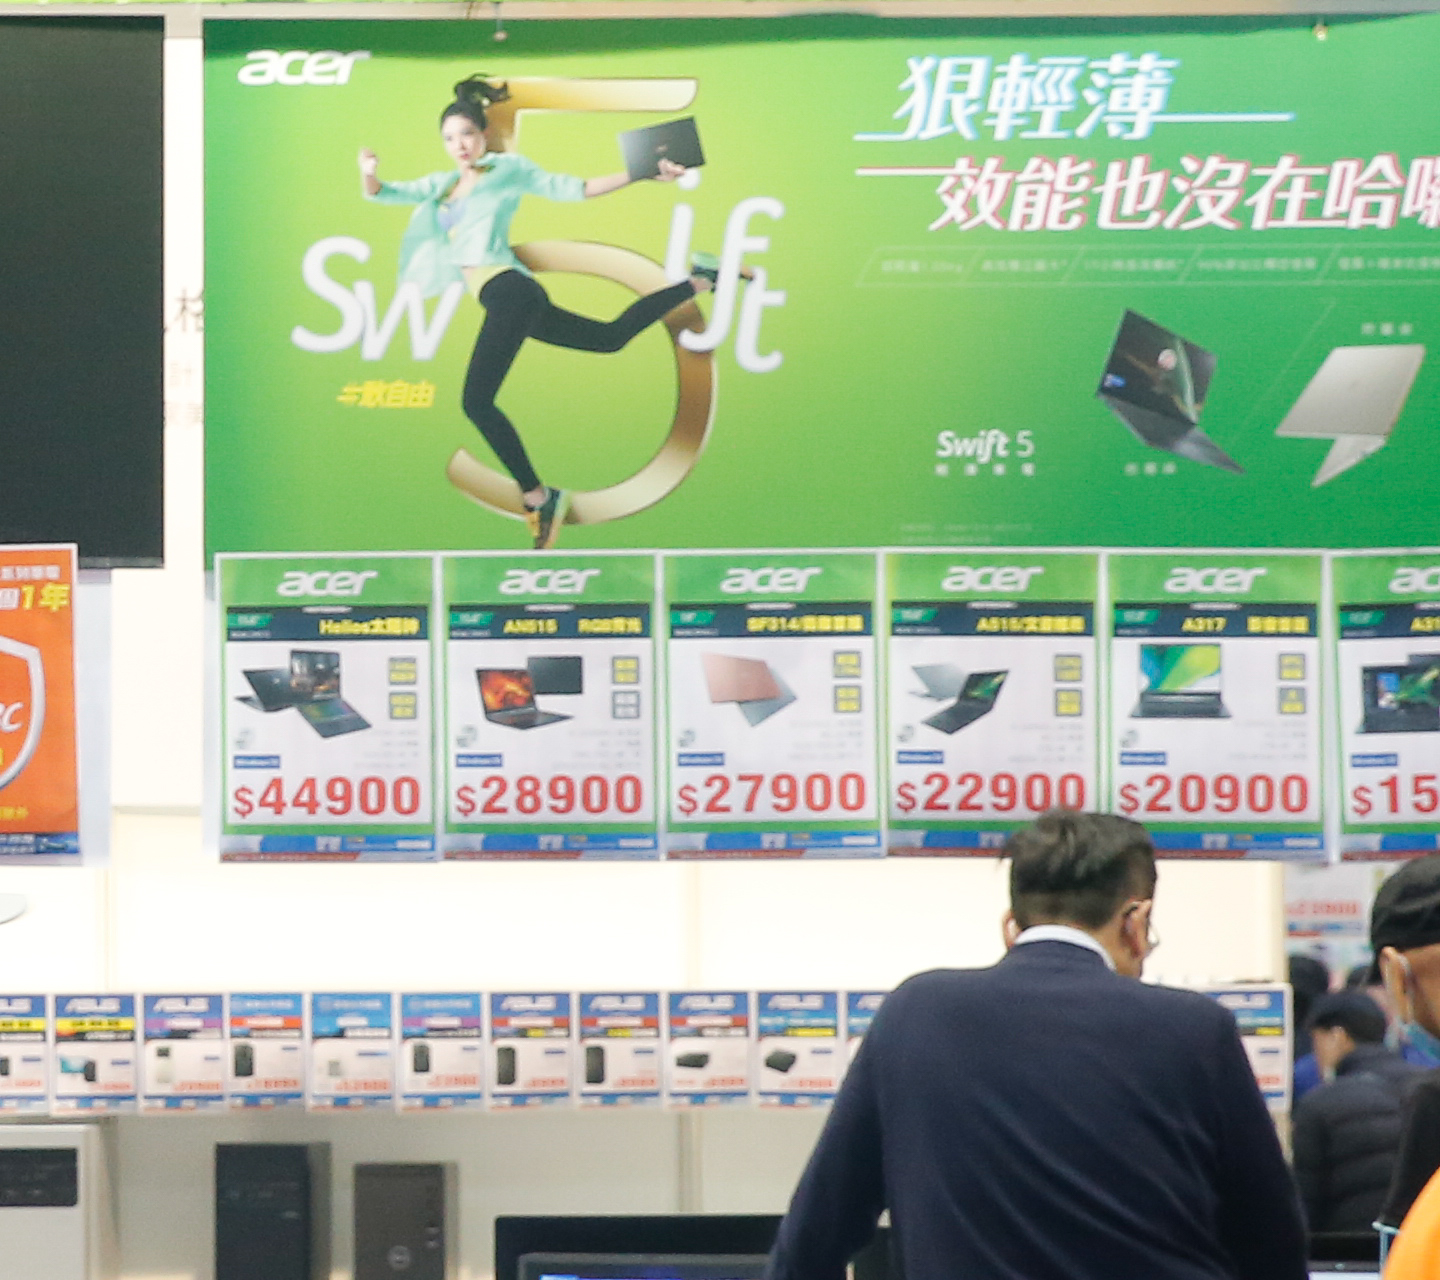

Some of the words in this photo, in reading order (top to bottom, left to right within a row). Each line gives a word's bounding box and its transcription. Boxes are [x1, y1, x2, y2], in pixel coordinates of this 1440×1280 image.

[237, 50, 370, 86] acer
[893, 53, 1180, 141] 狠輕薄
[936, 429, 1010, 459] Swift
[1016, 429, 1035, 458] 5
[277, 569, 379, 597] acer
[499, 568, 601, 595] acer
[721, 566, 823, 594] acer
[942, 565, 1044, 593] acer
[1164, 566, 1268, 593] acer
[235, 776, 421, 817] $44900
[457, 775, 643, 815] $28900
[679, 772, 865, 814] $27900
[899, 772, 1085, 812] $22900
[1121, 773, 1309, 814] $20900
